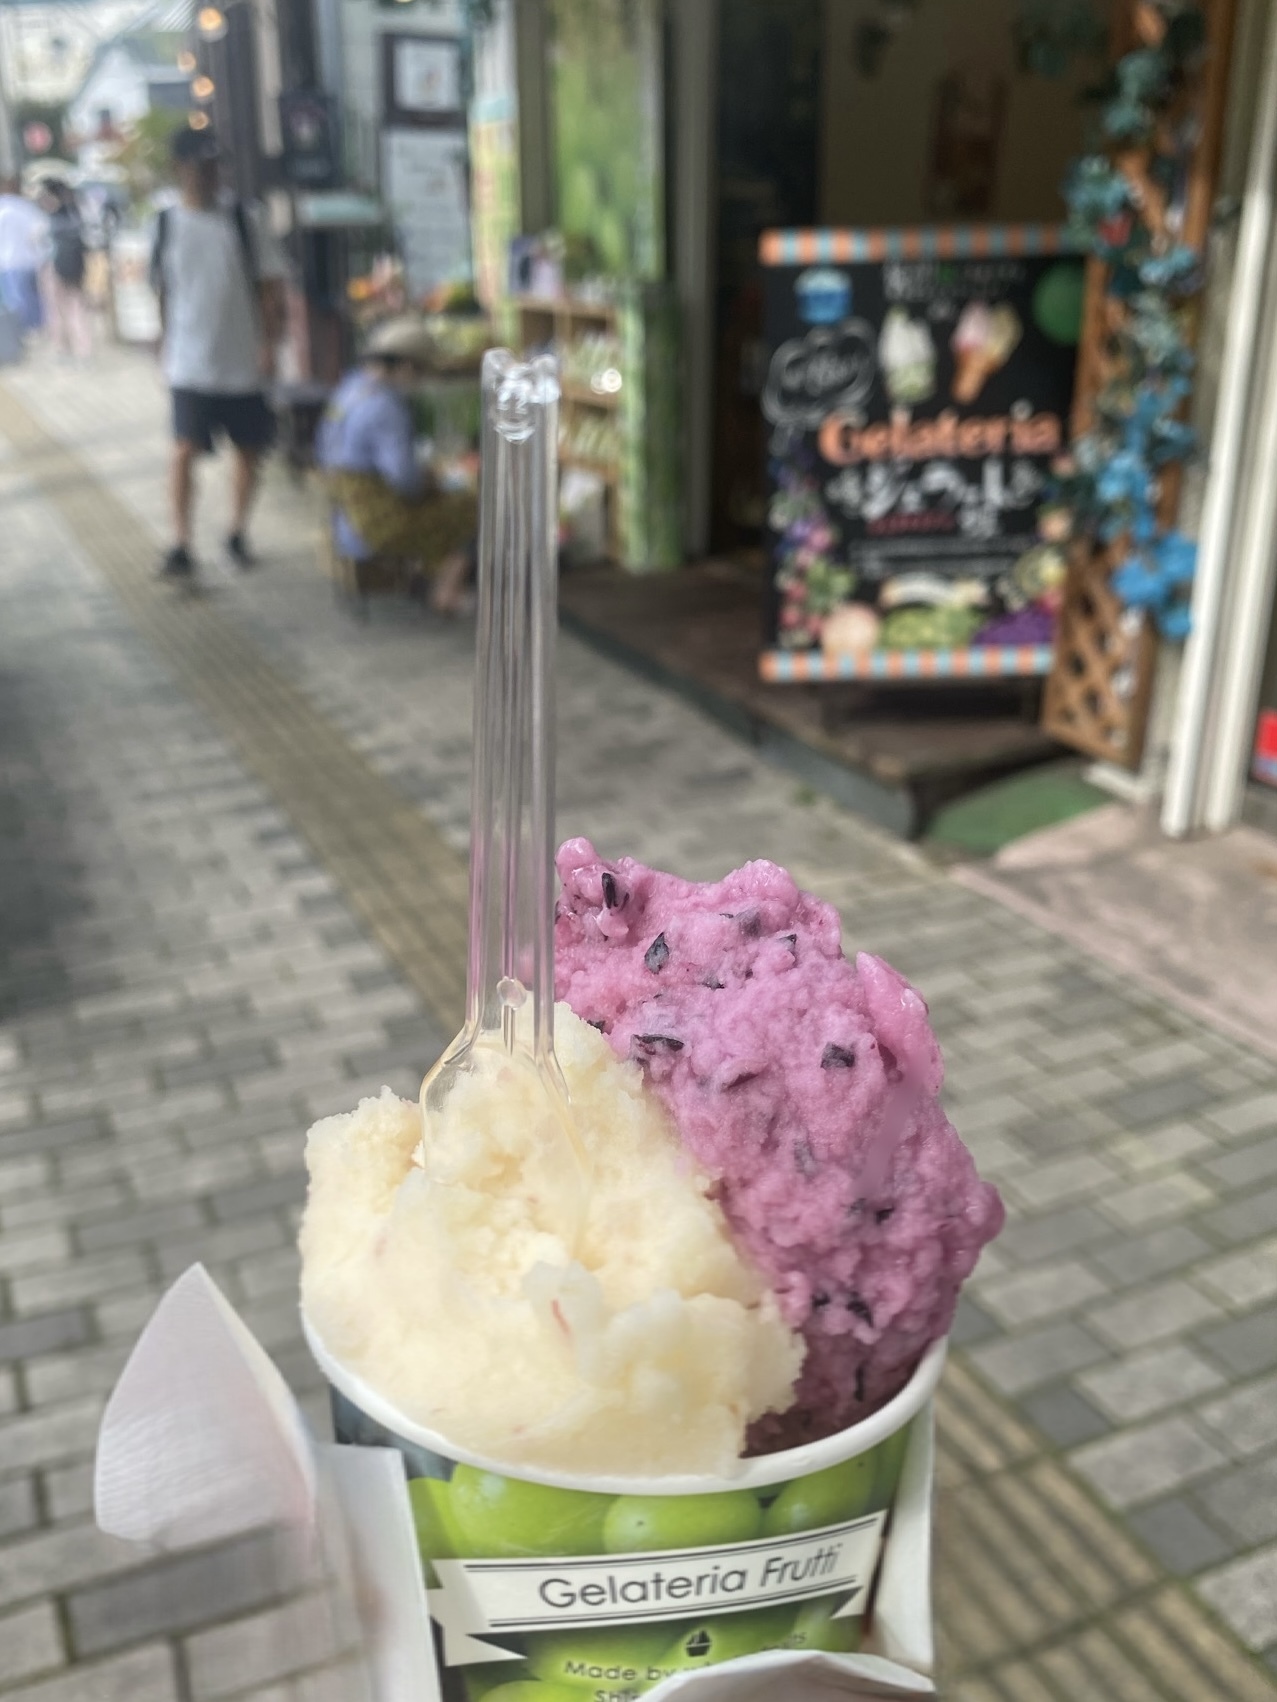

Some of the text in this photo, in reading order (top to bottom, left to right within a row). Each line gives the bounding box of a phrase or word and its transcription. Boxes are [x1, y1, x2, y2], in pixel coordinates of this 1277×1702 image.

[818, 403, 1061, 464] Gelateria
[540, 1543, 843, 1608] Gelateria Frutti
[565, 1661, 638, 1681] Made
